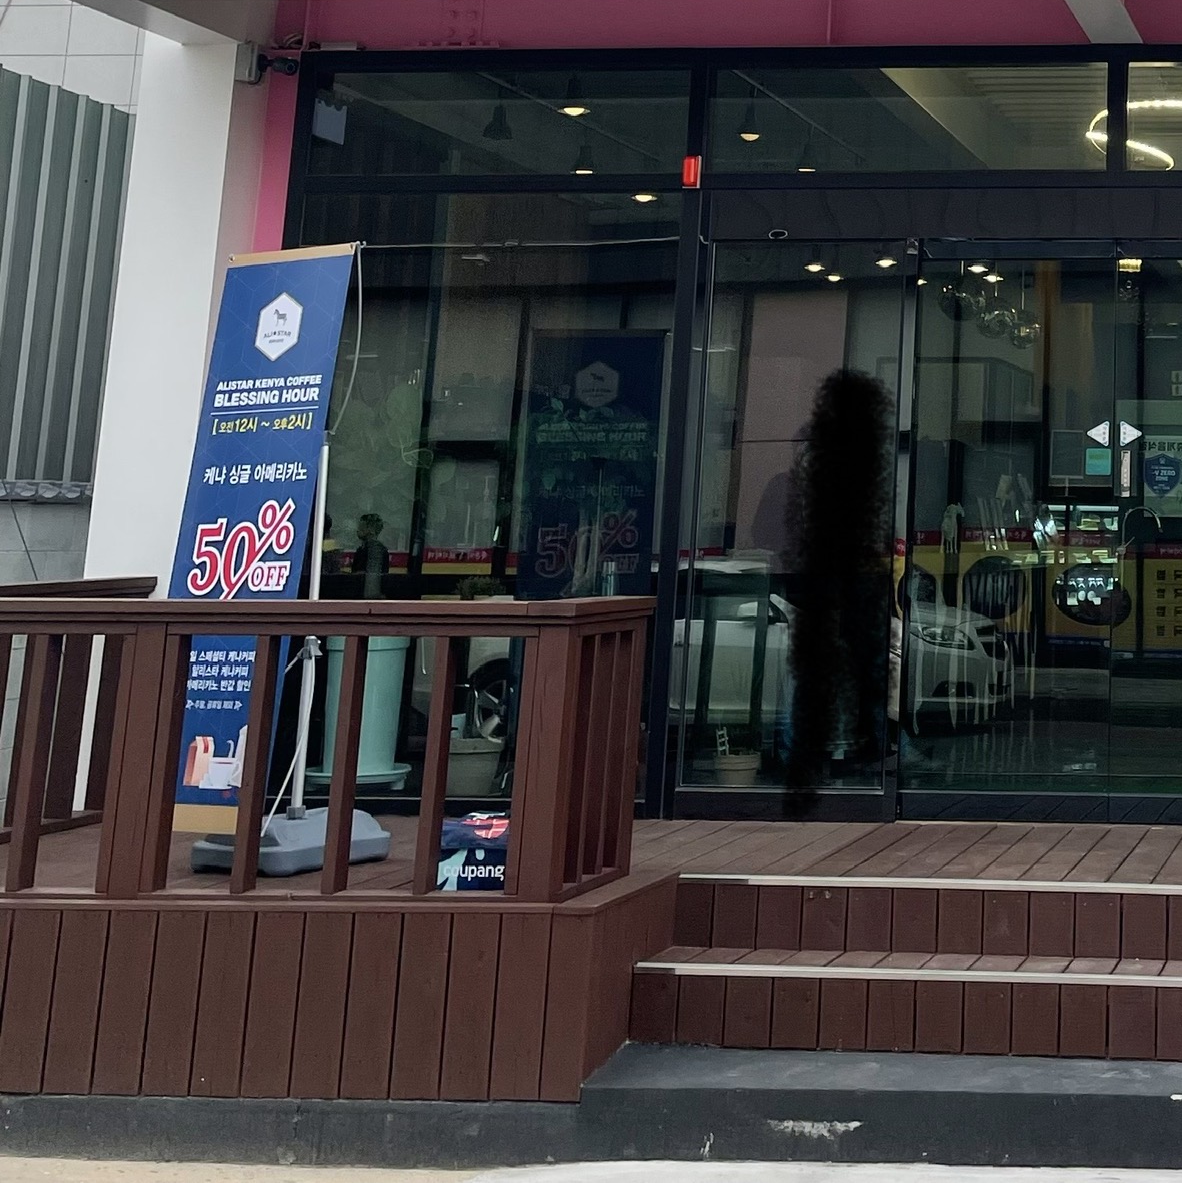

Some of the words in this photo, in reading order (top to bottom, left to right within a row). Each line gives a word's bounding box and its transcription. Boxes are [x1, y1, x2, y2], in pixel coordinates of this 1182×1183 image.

[216, 379, 254, 391] ALISTAR
[254, 377, 285, 389] KENYA
[286, 374, 322, 386] COFFEE
[213, 390, 280, 408] BLESSING
[281, 387, 320, 403] HOUR
[203, 465, 227, 485] 케냐
[229, 464, 252, 484] 싱글
[254, 461, 308, 483] 아메리카노
[187, 498, 296, 600] 50%
[248, 561, 291, 593] OFF
